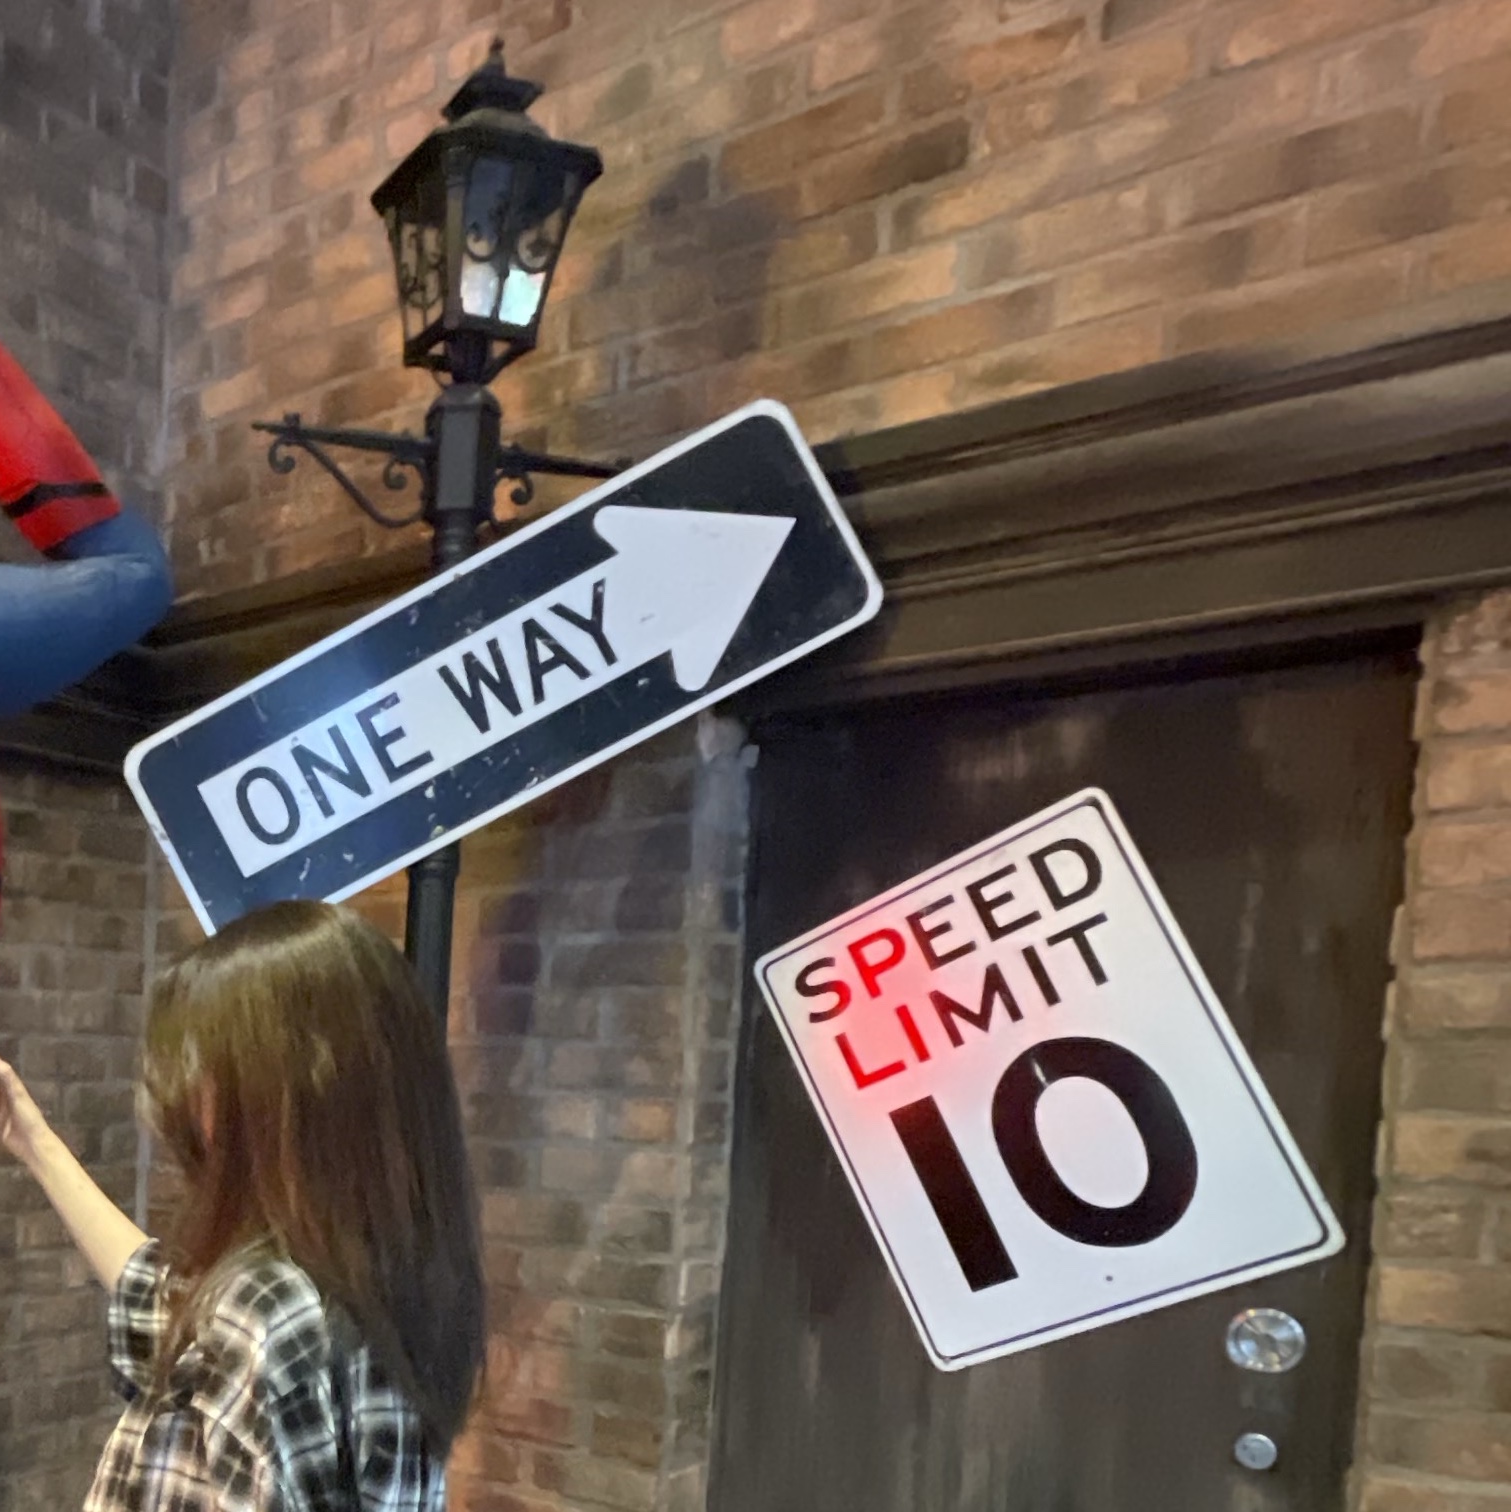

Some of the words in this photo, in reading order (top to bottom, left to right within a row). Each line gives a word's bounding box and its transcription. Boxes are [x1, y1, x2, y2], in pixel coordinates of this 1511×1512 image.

[234, 691, 434, 846] ONE
[437, 577, 621, 735] WAY
[793, 837, 1104, 1024] SPEED
[834, 912, 1110, 1092] LIMIT
[888, 1035, 1199, 1293] 10
